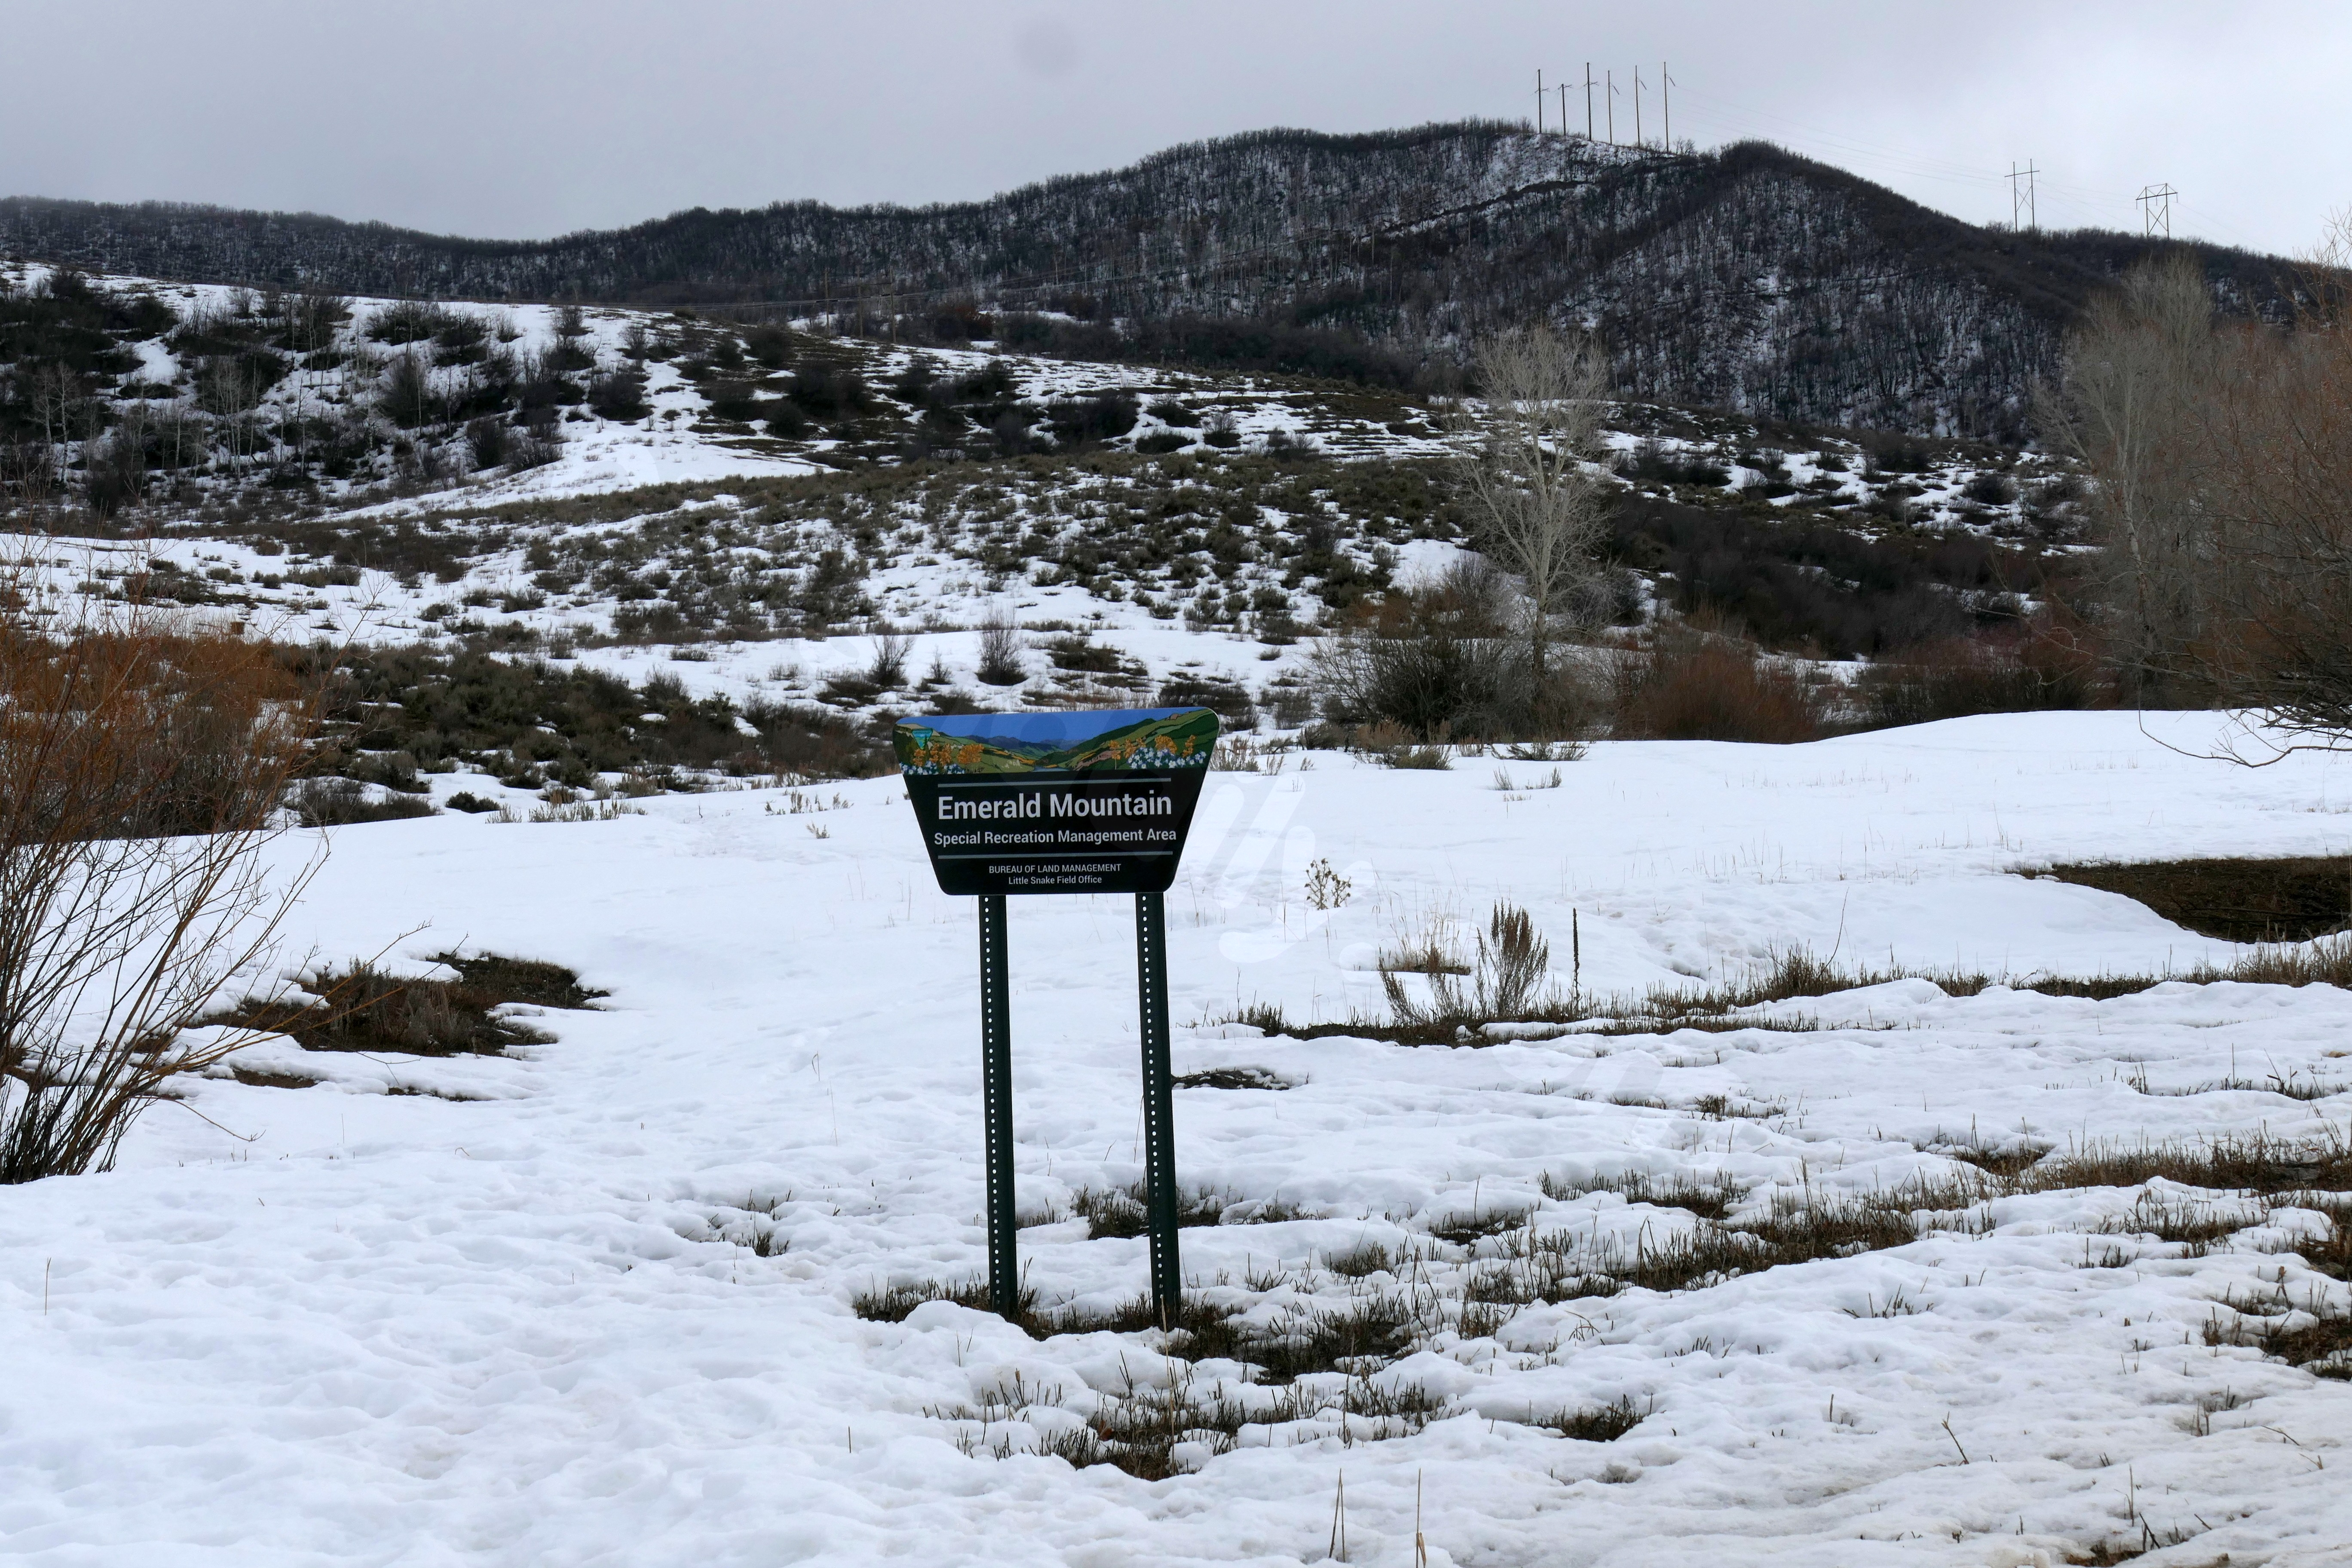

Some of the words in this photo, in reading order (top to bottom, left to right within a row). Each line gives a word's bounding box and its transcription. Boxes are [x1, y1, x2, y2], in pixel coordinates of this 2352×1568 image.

[938, 792, 1041, 820] Emerald
[1050, 790, 1171, 817] Mountain
[934, 831, 980, 848] Special
[985, 830, 1054, 844] Recreation
[1058, 829, 1143, 845] Management
[1146, 828, 1176, 840] Area
[989, 865, 1022, 873] BUREAU
[1062, 864, 1121, 872] MANAGEMENT
[1009, 876, 1029, 885] Little
[1031, 876, 1055, 884] Snake
[1057, 876, 1076, 884] Field
[1078, 875, 1102, 883] Office
